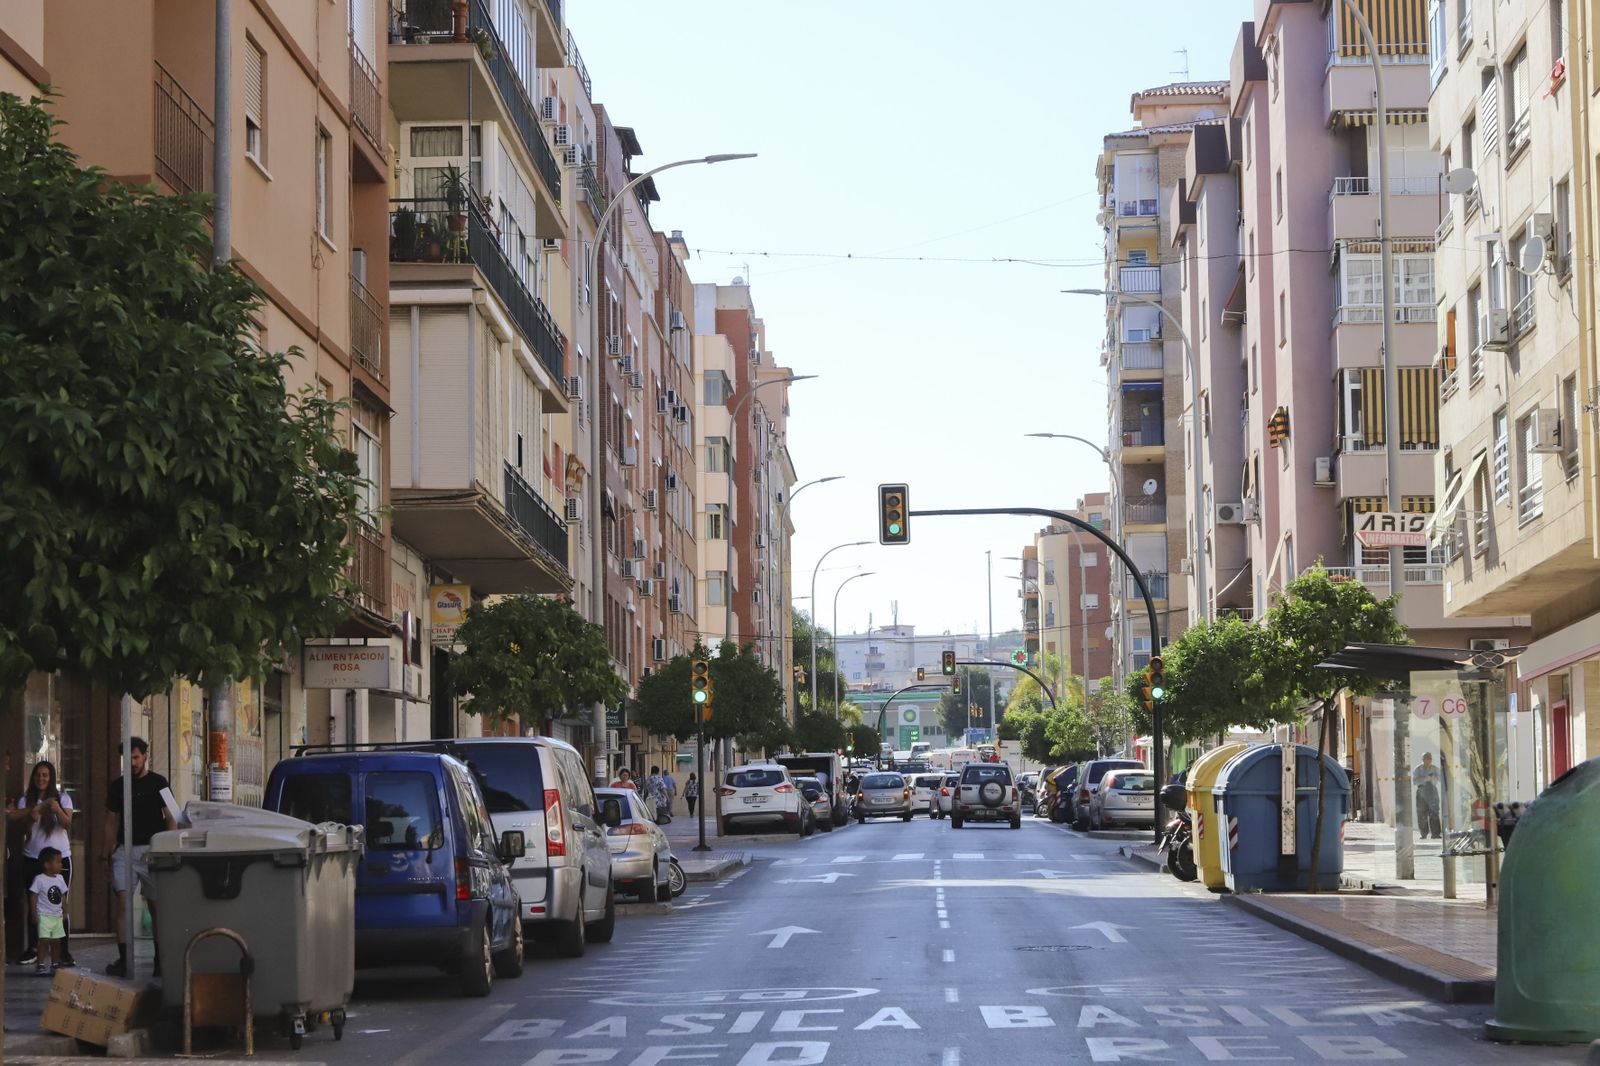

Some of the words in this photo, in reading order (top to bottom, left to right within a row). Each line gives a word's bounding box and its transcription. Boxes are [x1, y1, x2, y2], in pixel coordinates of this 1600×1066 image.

[1365, 532, 1427, 545] INFORMATICA
[308, 652, 385, 661] ALIMENTACION
[333, 663, 360, 671] ROSA
[1420, 699, 1430, 715] 7
[1441, 698, 1466, 714] C6
[480, 1006, 922, 1042] BASICA
